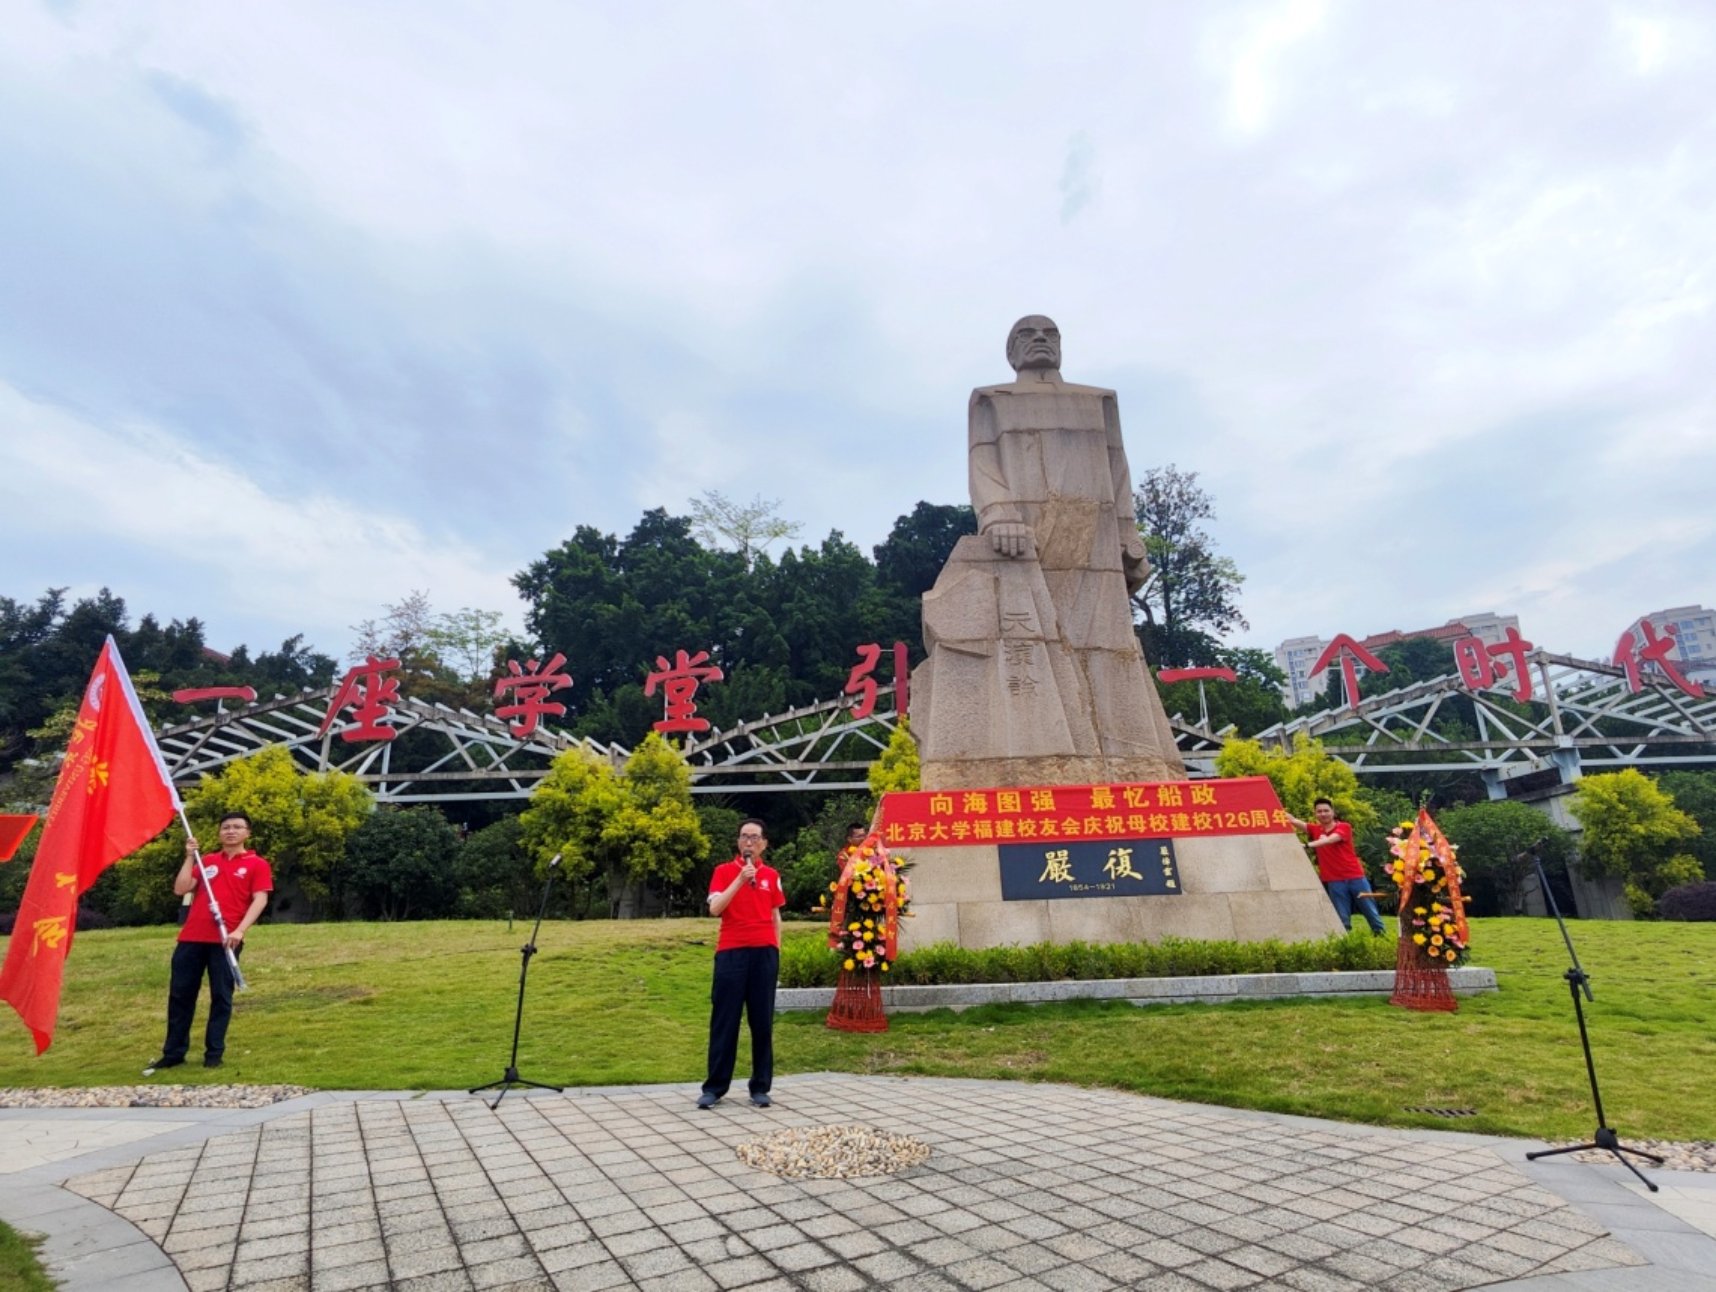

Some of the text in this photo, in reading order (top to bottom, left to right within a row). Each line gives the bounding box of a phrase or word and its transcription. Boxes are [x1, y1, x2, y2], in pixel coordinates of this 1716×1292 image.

[1156, 616, 1706, 710] 一个时代
[929, 783, 1218, 816] 向海图强 最忆船政
[885, 808, 1291, 842] 北京大学福建校友会庆祝母校建校126周年
